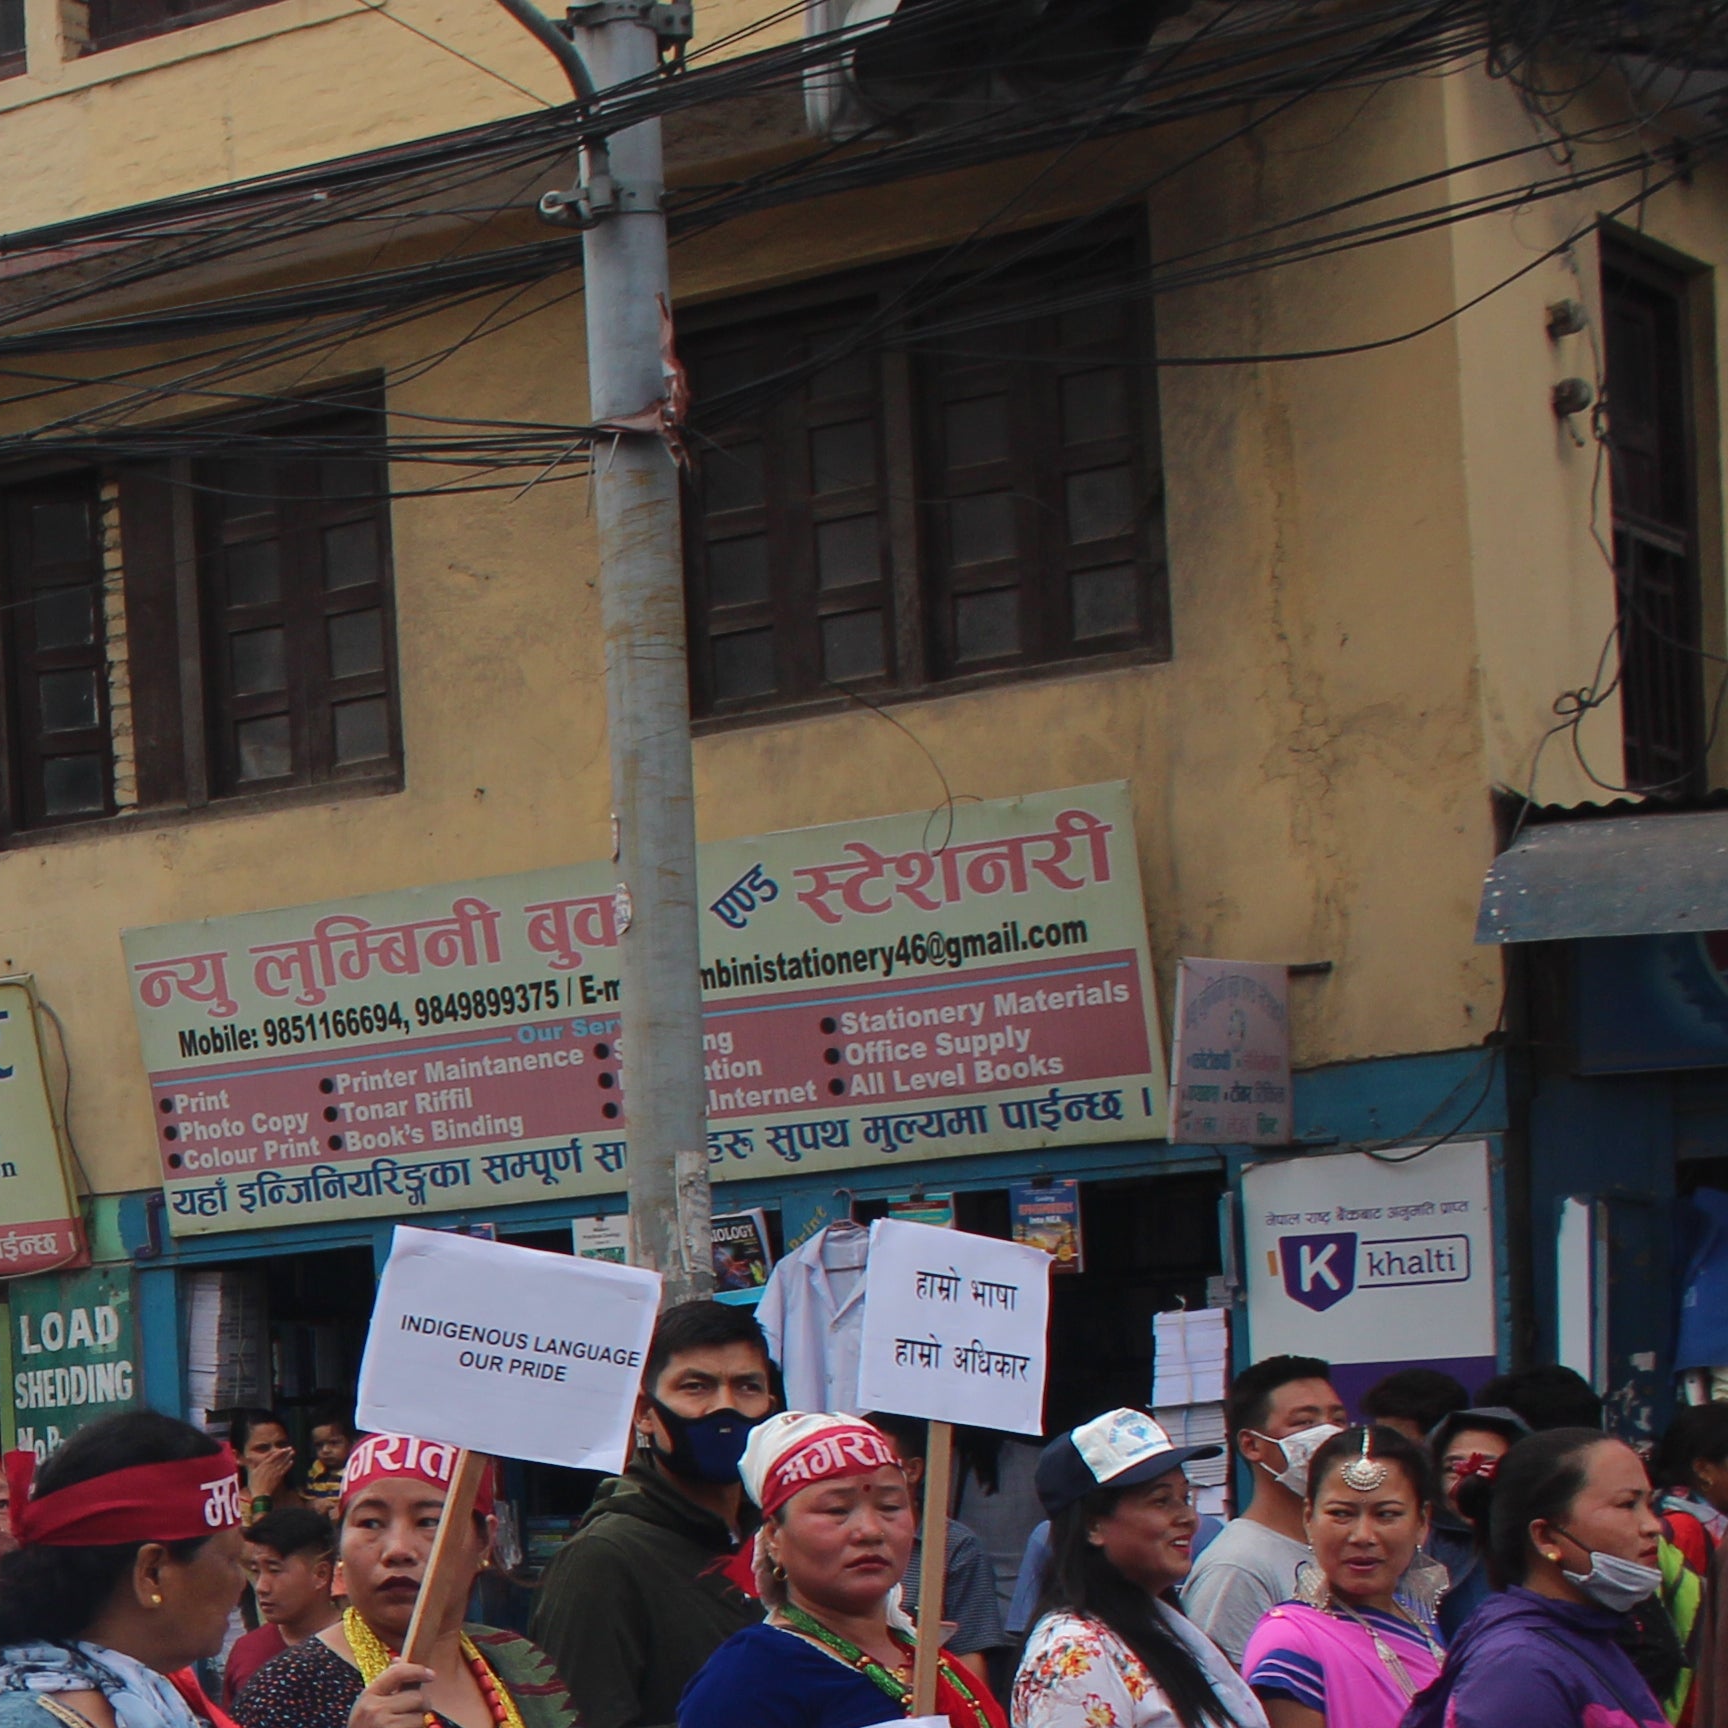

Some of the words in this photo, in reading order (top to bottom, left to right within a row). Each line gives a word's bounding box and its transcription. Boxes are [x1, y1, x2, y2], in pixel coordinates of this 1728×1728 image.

[134, 951, 240, 1018] न्यु
[249, 896, 503, 1006] लुम्बिनी
[792, 809, 1114, 925] स्टेशनरी
[179, 1026, 259, 1058] Mobile:
[263, 1000, 410, 1048] 9851166694,
[415, 979, 560, 1024] 9849899375
[840, 1000, 986, 1036] Stationery
[993, 980, 1130, 1017] Materials
[517, 1022, 568, 1044] Our
[844, 1037, 930, 1067] Office
[936, 1026, 1031, 1058] Supply
[336, 1067, 417, 1096] Printer
[425, 1046, 585, 1085] Maintanence
[849, 1071, 887, 1097] All
[895, 1063, 966, 1092] Level
[973, 1054, 1064, 1083] Books
[174, 1089, 230, 1115] Print
[340, 1098, 408, 1124] Tonar
[414, 1086, 474, 1115] Riffil
[179, 1117, 245, 1144] Photo
[252, 1111, 310, 1140] Copy
[431, 1112, 525, 1144] Binding
[172, 1179, 227, 1217] यहाँ
[481, 1137, 583, 1187] सम्पूर्ण
[765, 1118, 849, 1162] सुपथ
[862, 1104, 987, 1154] मुल्यमा
[183, 1146, 257, 1172] Colour
[264, 1136, 321, 1161] Print
[1265, 1213, 1300, 1226] नेपाल
[916, 1266, 963, 1304] हाम्रो
[970, 1279, 1019, 1312] भाषा
[1300, 1243, 1341, 1292] K
[1367, 1246, 1456, 1277] khalti
[20, 1305, 119, 1355] LOAD
[400, 1314, 529, 1350] INDIGENOUS
[534, 1336, 642, 1368] LANGUAGE
[459, 1351, 503, 1373] OUR
[508, 1359, 567, 1383] PRIDE
[894, 1332, 943, 1370] हाम्रो
[952, 1339, 1032, 1383] अधिकार
[15, 1361, 133, 1410] SHEDDING
